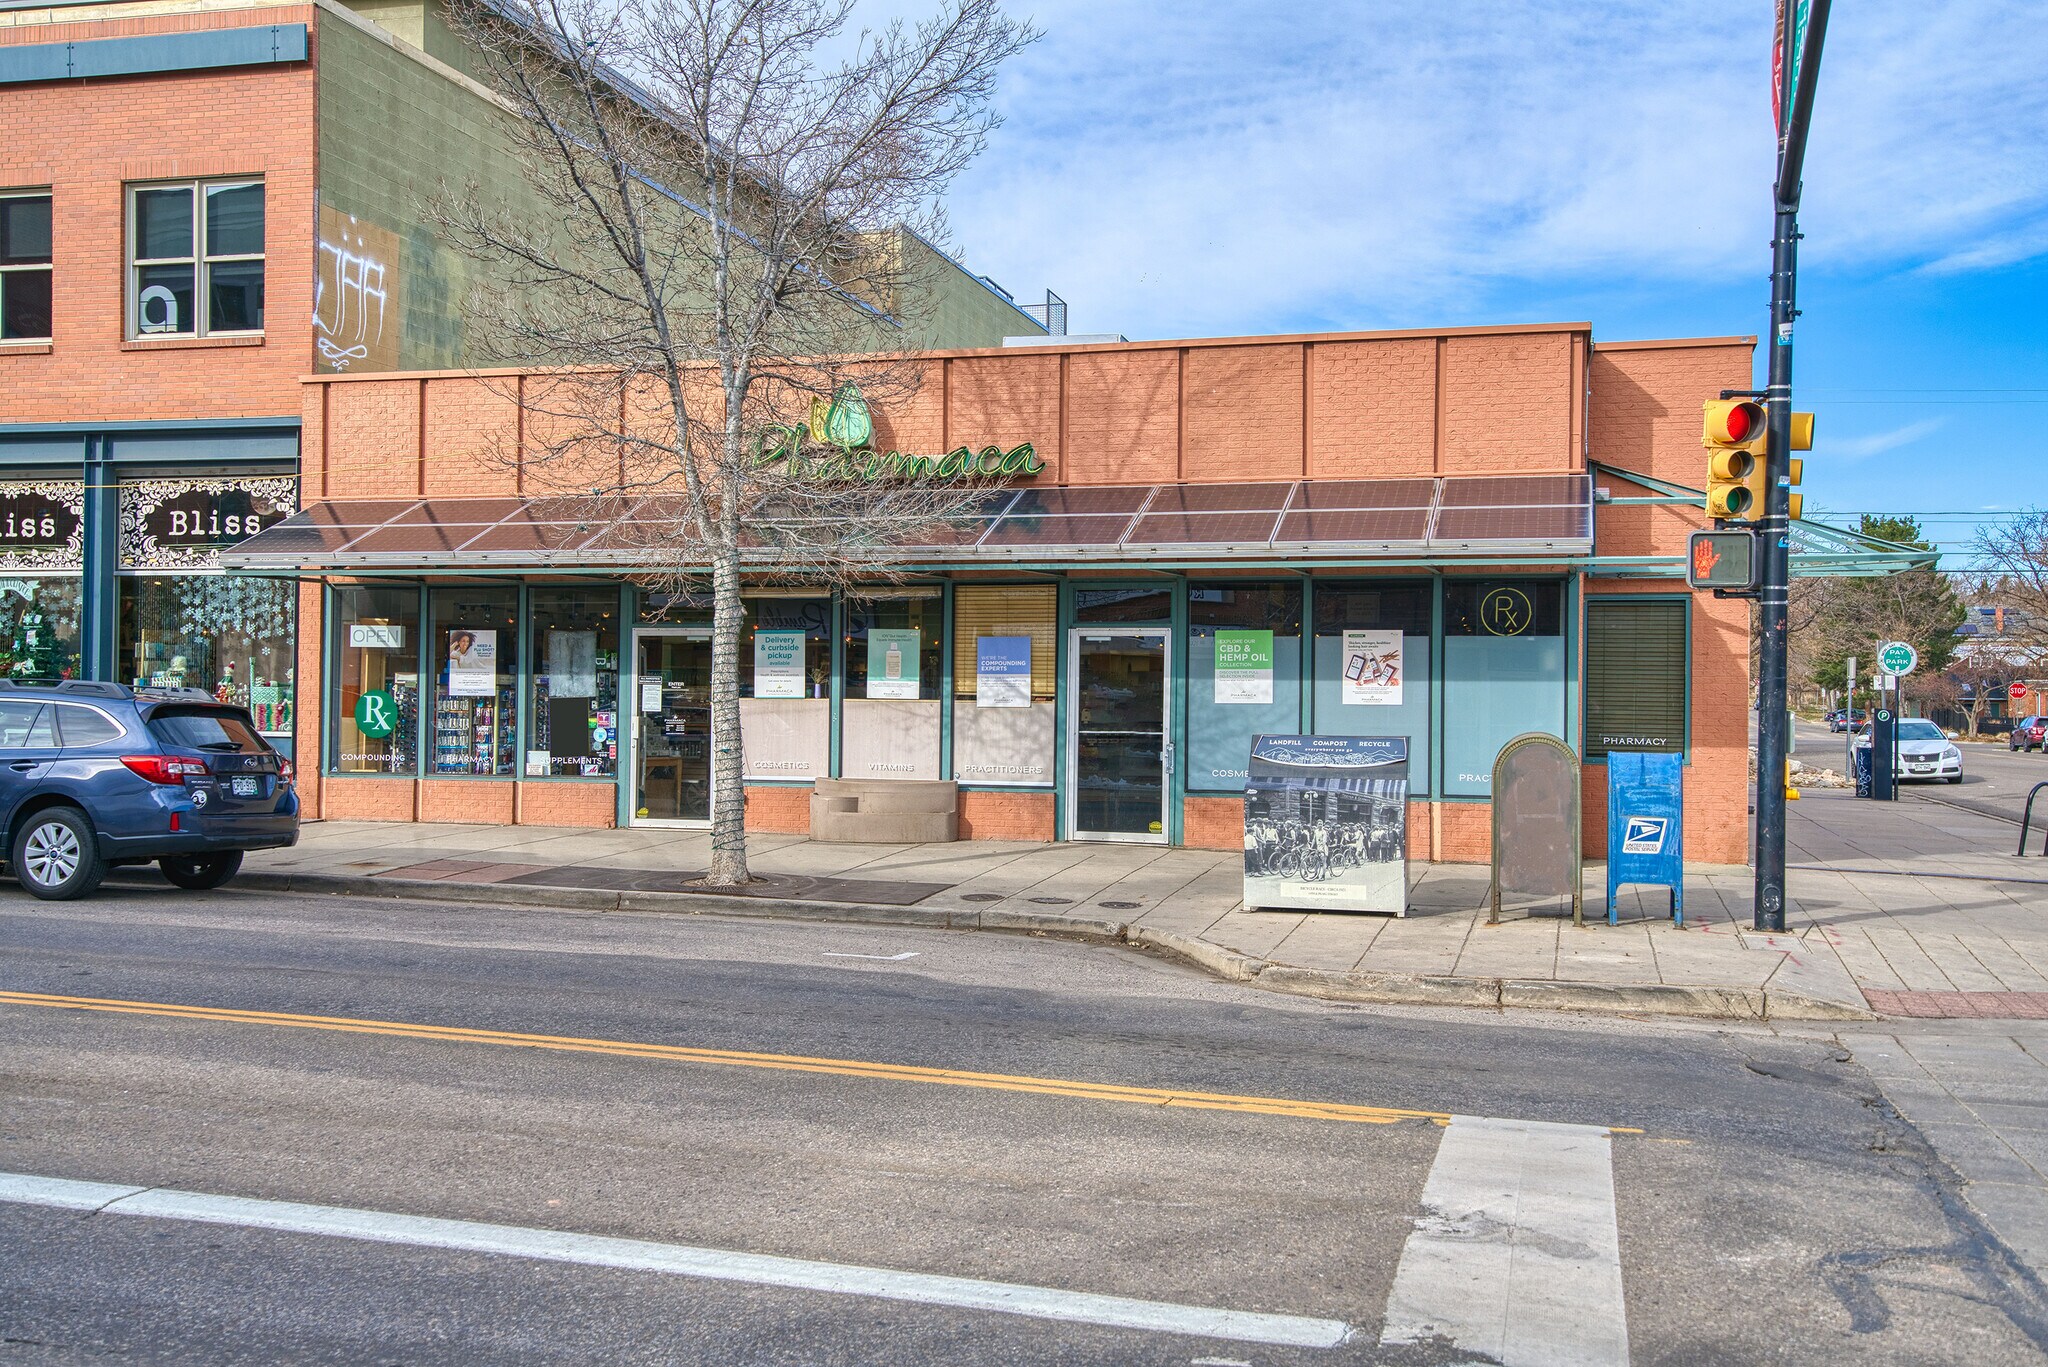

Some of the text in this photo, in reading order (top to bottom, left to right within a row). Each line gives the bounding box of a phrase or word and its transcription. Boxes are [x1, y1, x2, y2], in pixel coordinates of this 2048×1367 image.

[752, 422, 1045, 480] Pharmaca
[0, 513, 56, 538] iss
[168, 510, 261, 536] Bliss
[353, 629, 399, 643] OPEN
[765, 636, 795, 644] Delivery
[1219, 644, 1251, 653] CBD &
[767, 652, 792, 660] pickup
[1219, 653, 1269, 662] HEMP OIL
[2010, 687, 2026, 695] STOP
[363, 695, 391, 730] Rx
[1603, 737, 1667, 746] PHARMACY
[341, 753, 406, 762] COMPOUNDING
[446, 755, 494, 763] PHARMACY
[540, 756, 603, 765] SUPPLEMENTS
[753, 761, 810, 770] COSMETICS
[868, 763, 915, 772] VITAMINS
[965, 764, 1043, 775] PRACTITIONERS
